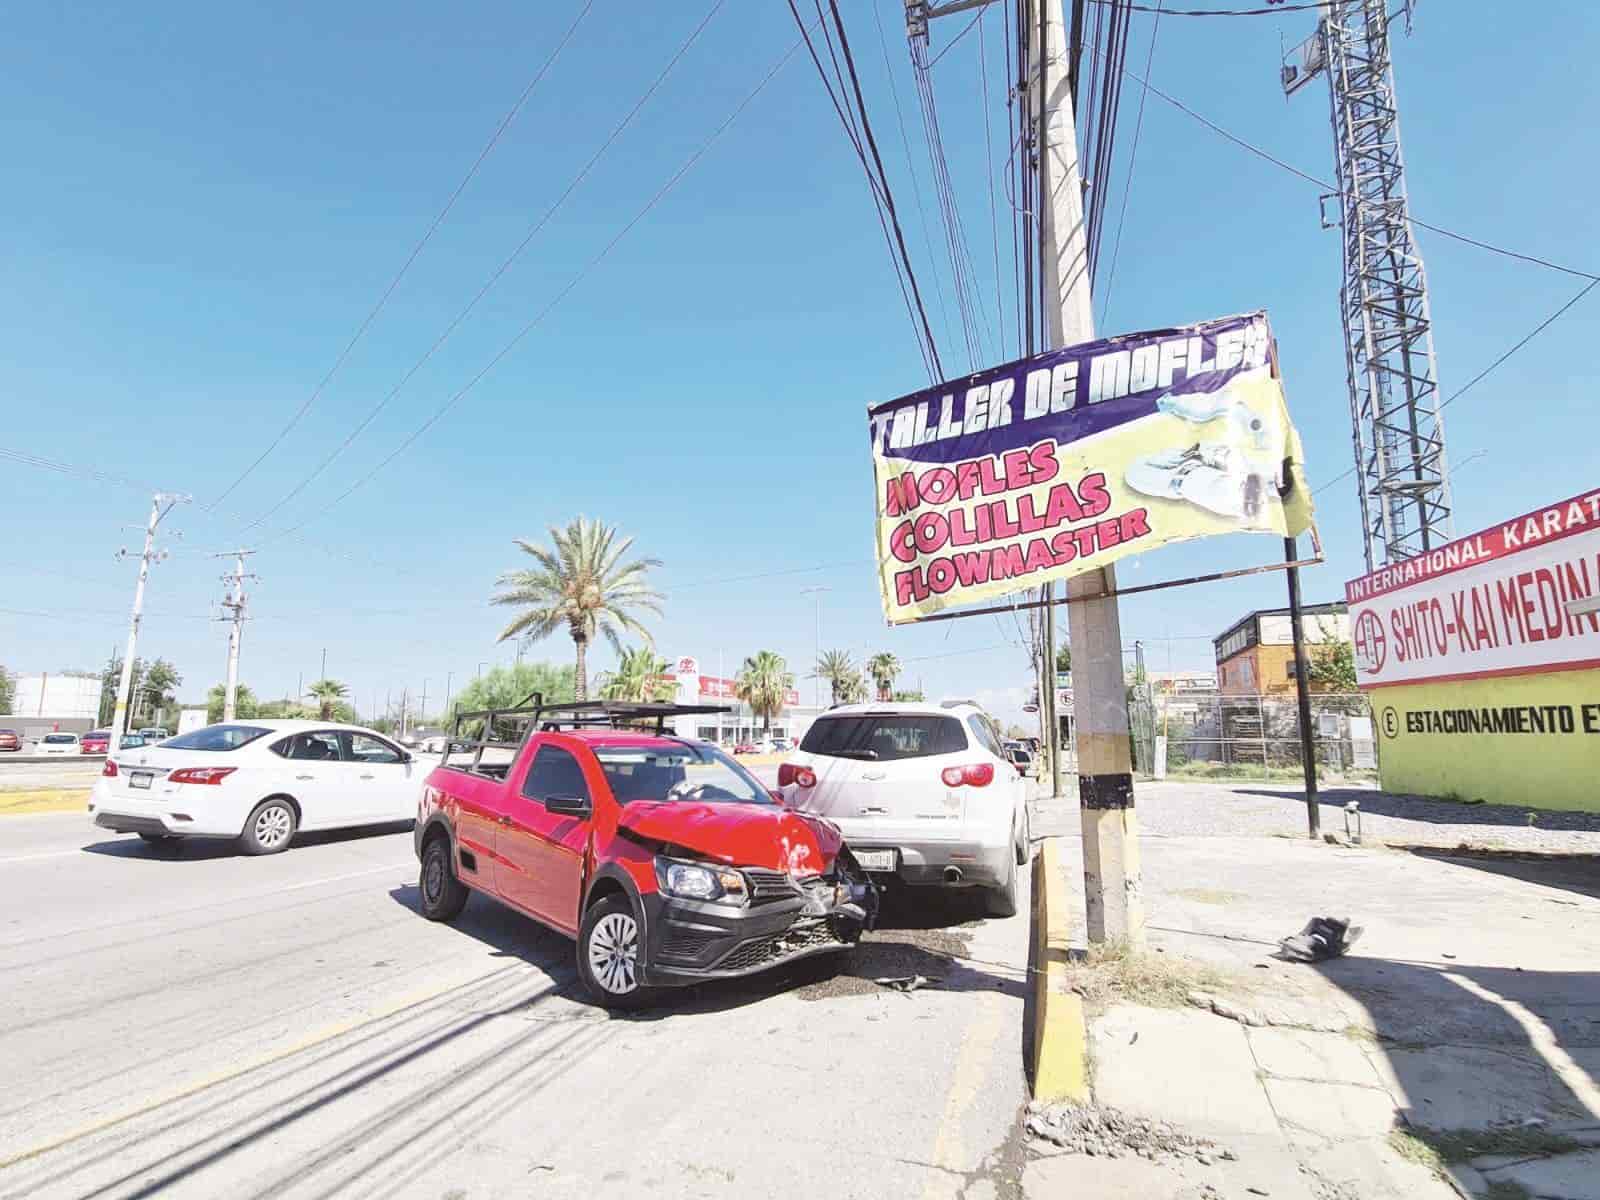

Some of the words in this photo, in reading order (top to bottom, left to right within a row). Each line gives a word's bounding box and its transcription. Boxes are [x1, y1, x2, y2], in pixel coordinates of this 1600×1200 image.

[871, 378, 1015, 453] TALLER
[1024, 361, 1079, 420] DE
[886, 441, 1060, 517] MOFLES
[891, 473, 1111, 562] COLILLAS
[896, 508, 1152, 606] FLOWMASTER
[1350, 538, 1491, 601] INTERNATIONAL
[1391, 580, 1500, 663] SHITO-KAI
[1497, 553, 1600, 645] MEDIN
[1406, 705, 1575, 735] ESTACIONAMIENTO
[1582, 704, 1600, 734] E
